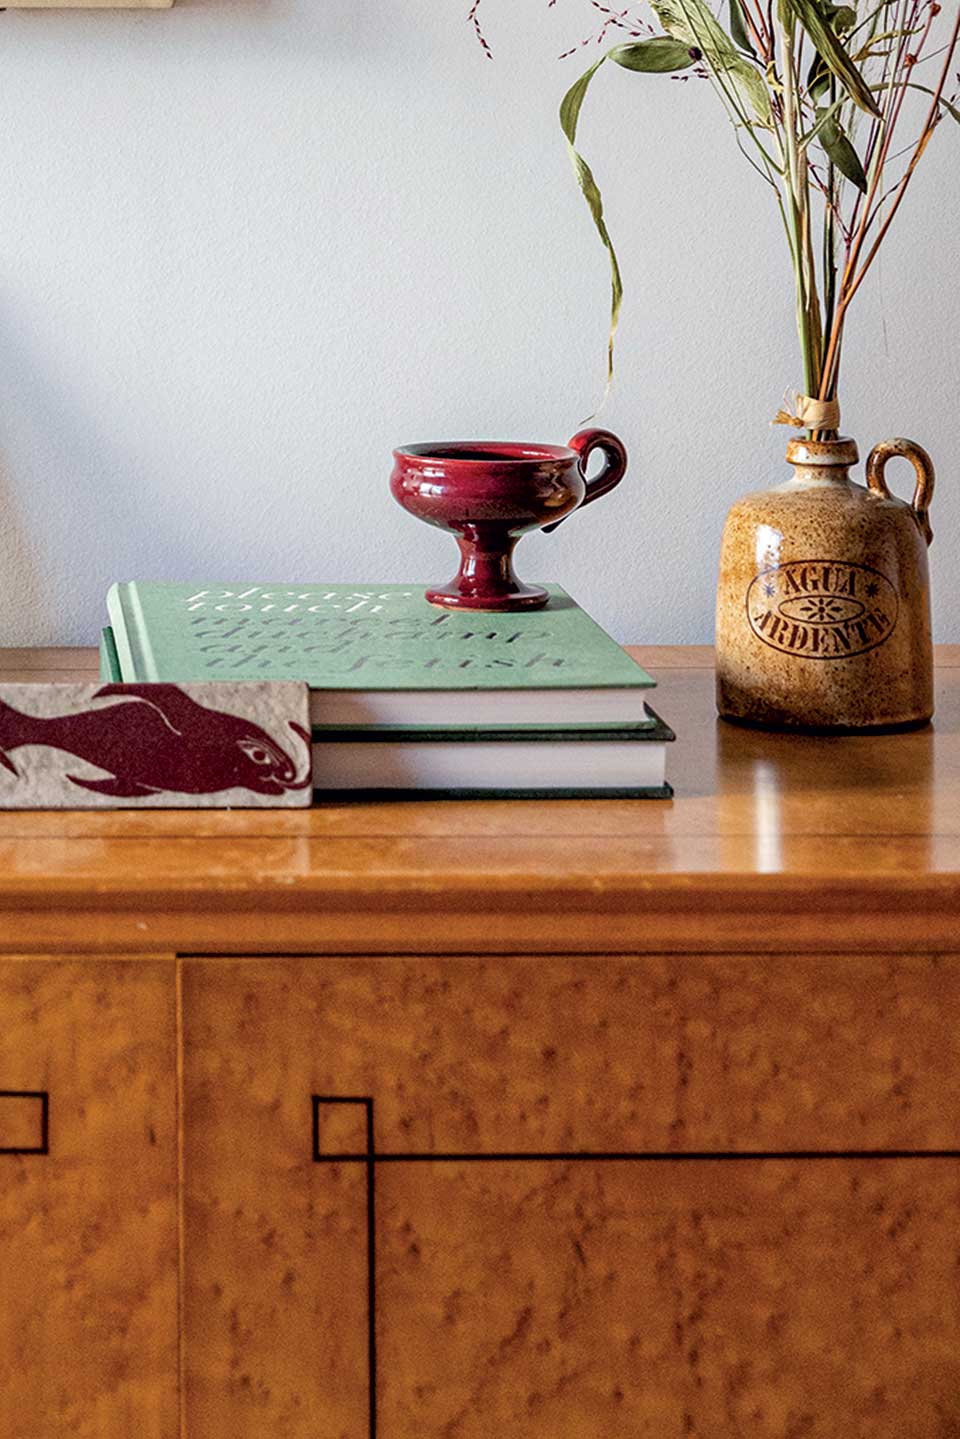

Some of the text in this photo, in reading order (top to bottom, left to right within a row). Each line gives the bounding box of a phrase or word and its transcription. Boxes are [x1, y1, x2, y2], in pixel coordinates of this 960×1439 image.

[784, 566, 856, 596] AGUA
[185, 587, 412, 603] please
[187, 600, 386, 614] touch
[194, 626, 554, 645] duchamp
[754, 608, 891, 653] ARDENTE
[199, 640, 353, 654] and
